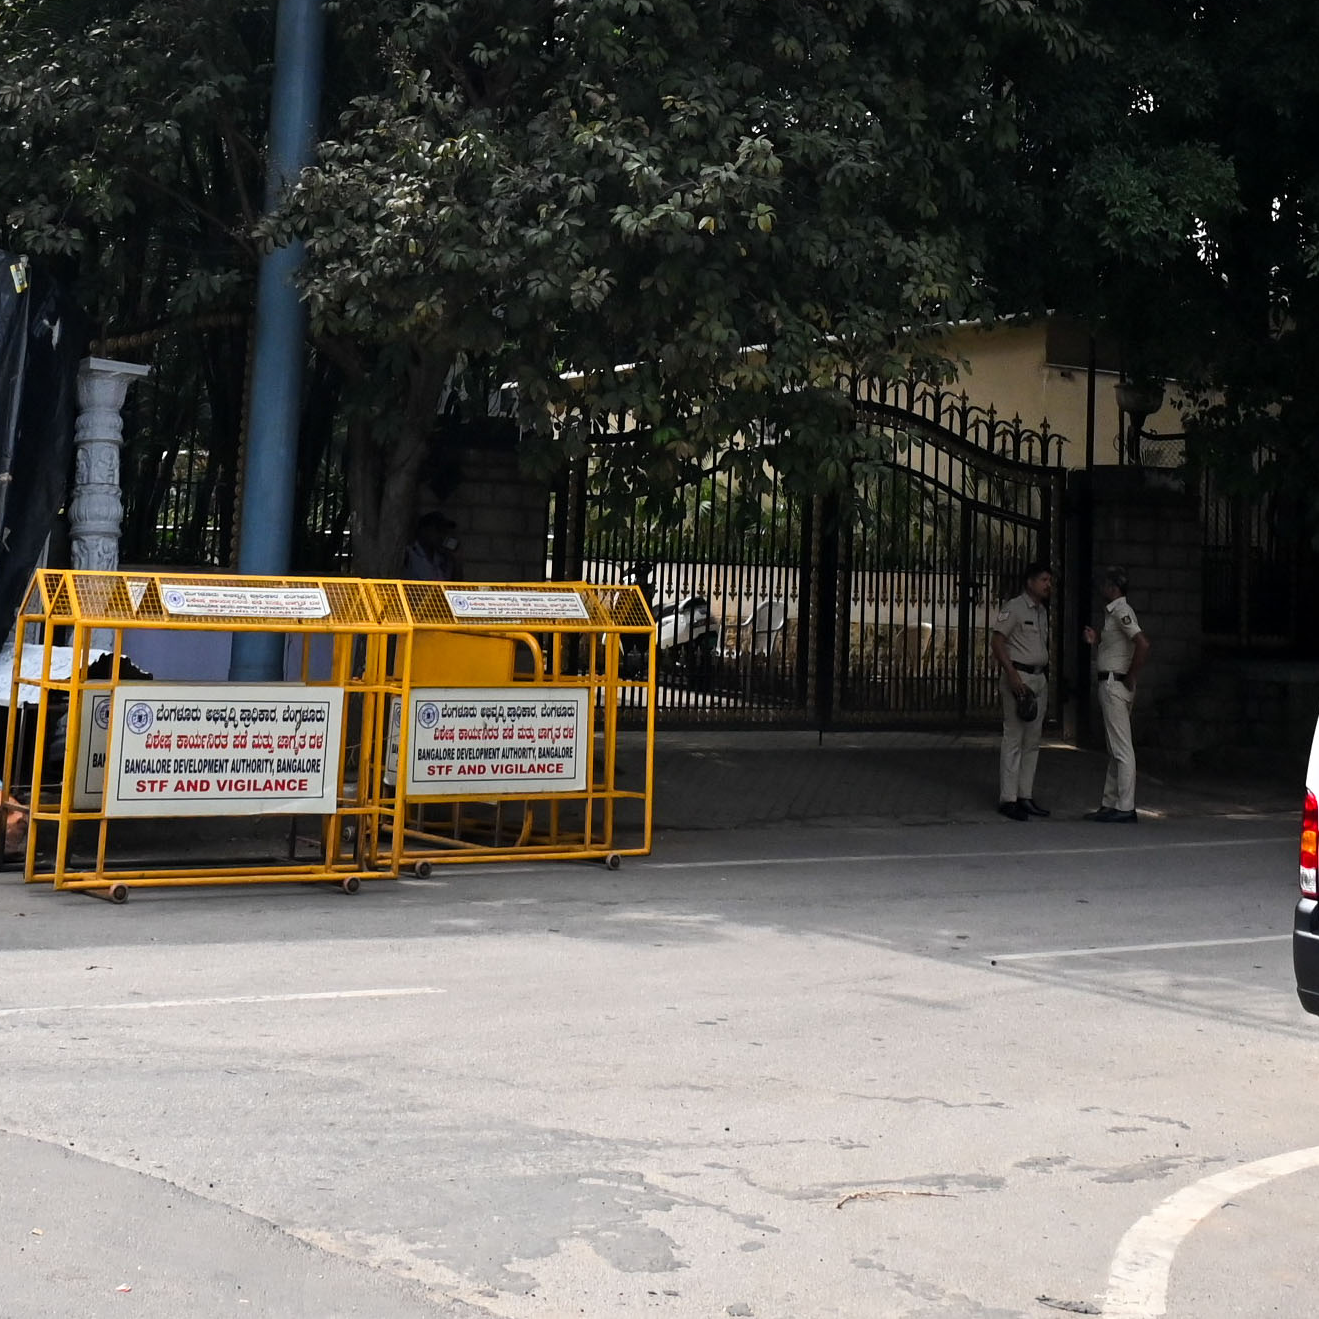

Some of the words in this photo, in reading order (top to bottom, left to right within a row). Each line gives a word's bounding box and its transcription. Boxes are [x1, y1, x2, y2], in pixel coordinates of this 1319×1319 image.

[418, 748, 455, 760] BANGALORE
[457, 748, 500, 760] DEVELOPMENT
[538, 747, 573, 758] BANGALORE
[125, 759, 171, 774] BANGALORE
[174, 759, 229, 774] DEVELOPMENT
[277, 758, 321, 773] BANGALORE
[427, 765, 452, 775] STF
[457, 765, 486, 775] AND
[491, 764, 563, 774] VIGILANCE
[136, 780, 168, 793] STF
[174, 780, 210, 792] AND
[218, 779, 308, 791] VIGILANCE
